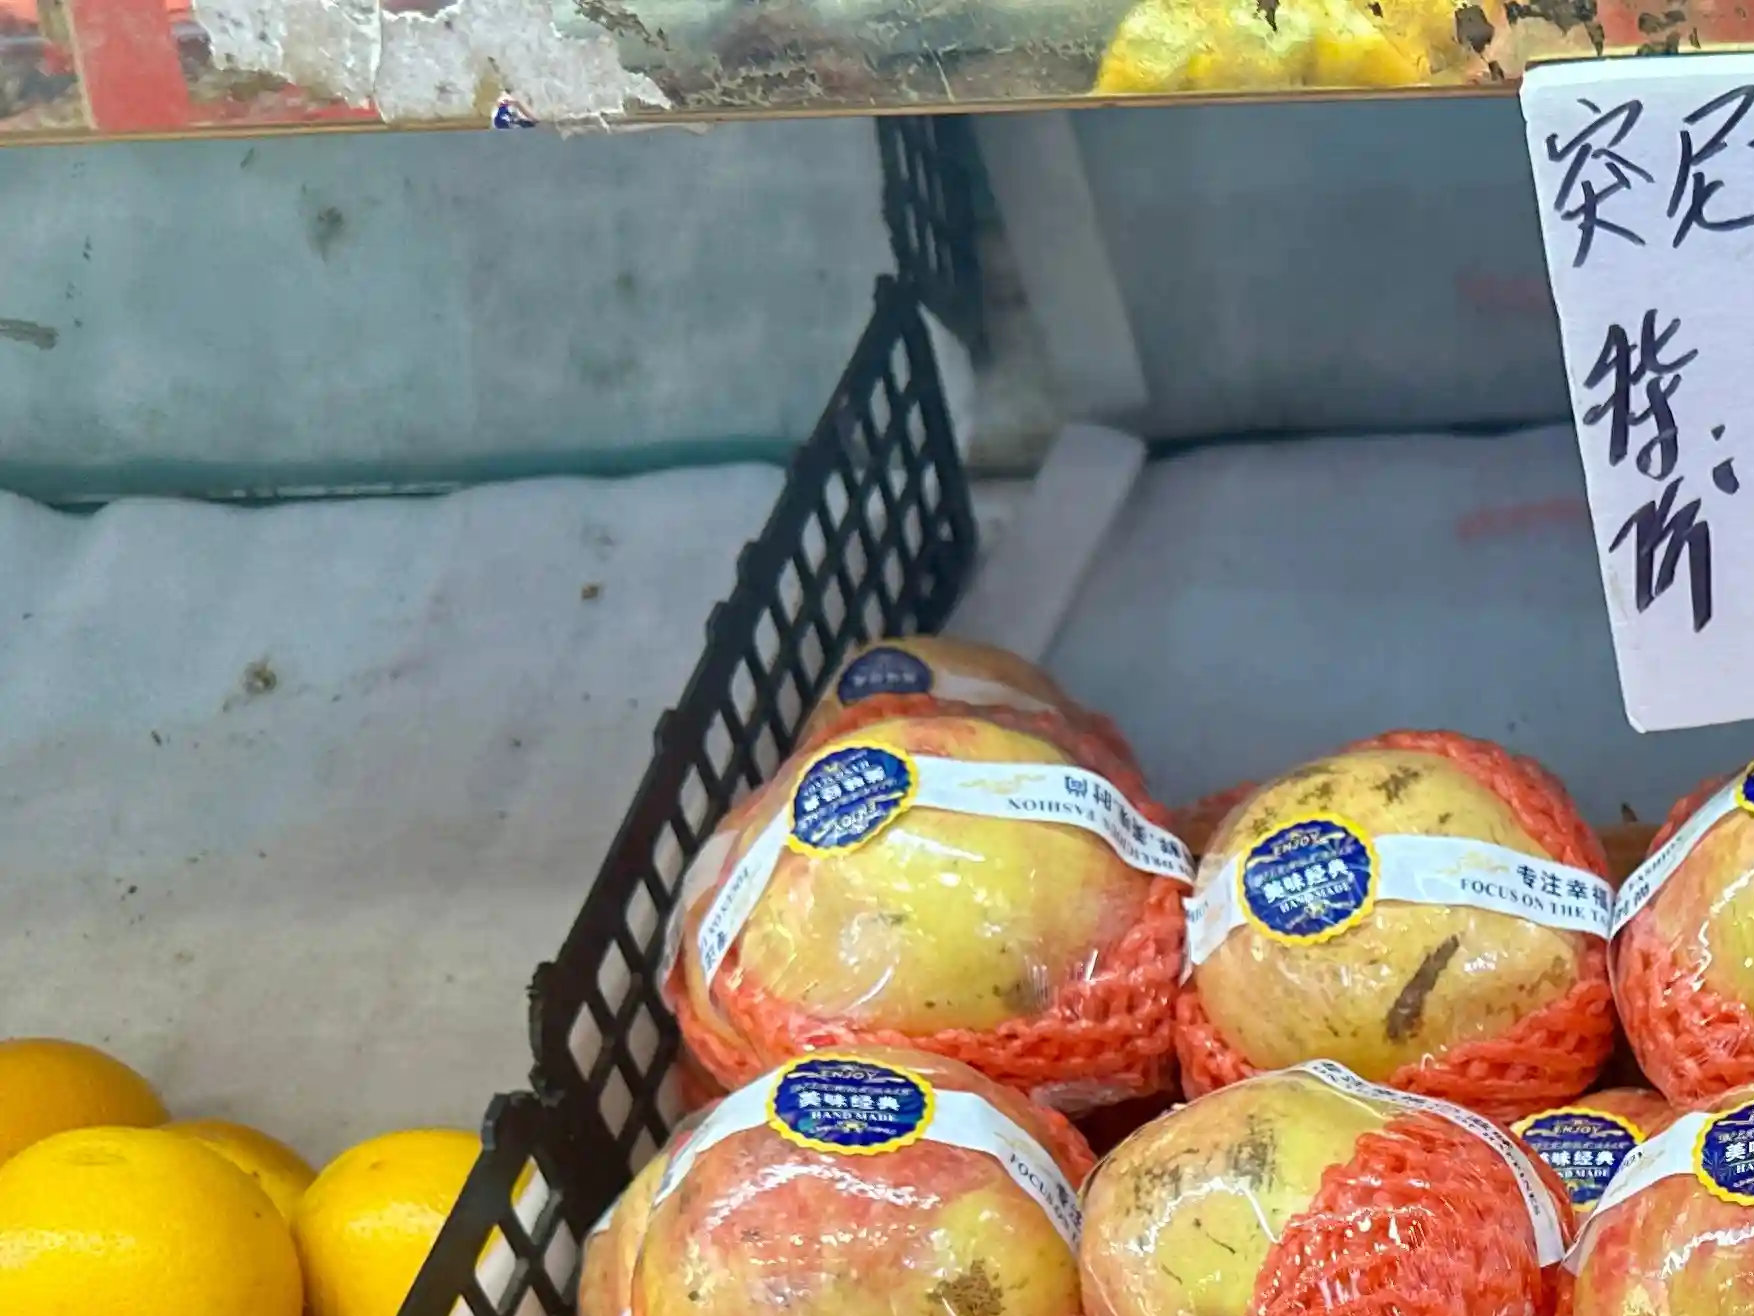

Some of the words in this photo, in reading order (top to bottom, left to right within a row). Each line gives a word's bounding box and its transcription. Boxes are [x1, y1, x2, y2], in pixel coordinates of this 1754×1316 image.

[1262, 859, 1353, 903] 美味经典
[1461, 878, 1517, 901] FOCUS
[1521, 896, 1545, 911] ON
[821, 1068, 877, 1083] ENJOY
[799, 1090, 901, 1113] 美味经典
[810, 1110, 850, 1123] HAND
[855, 1112, 896, 1123] MADE
